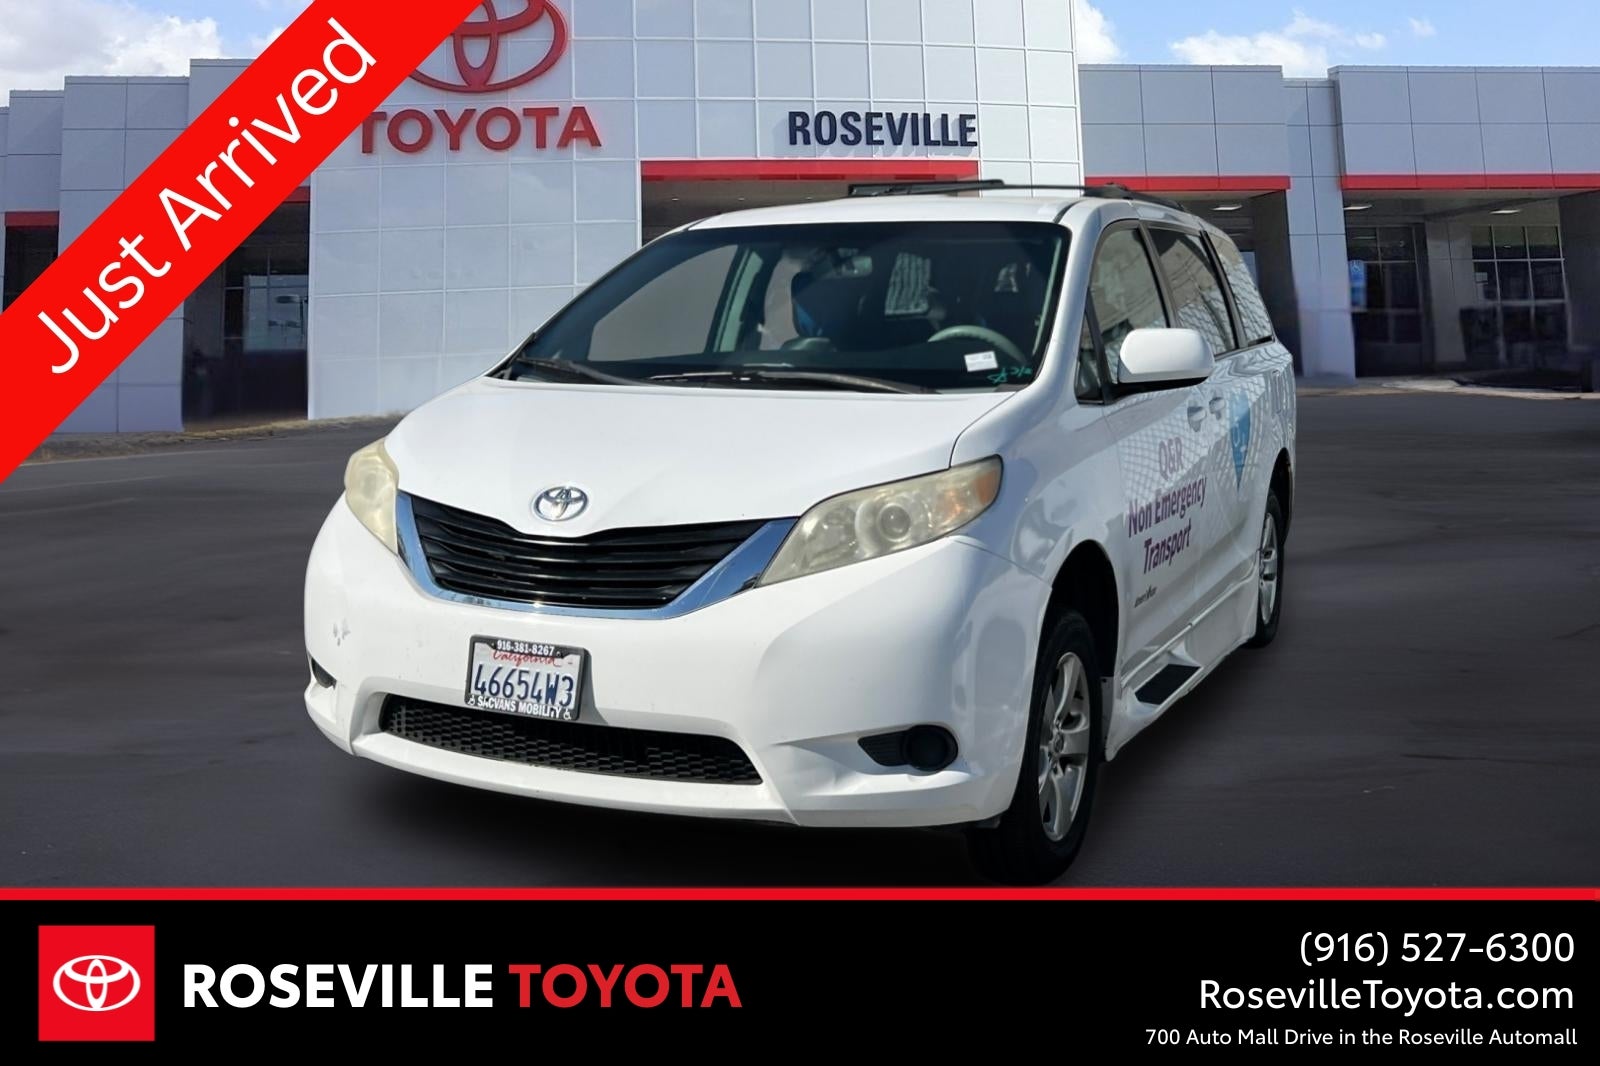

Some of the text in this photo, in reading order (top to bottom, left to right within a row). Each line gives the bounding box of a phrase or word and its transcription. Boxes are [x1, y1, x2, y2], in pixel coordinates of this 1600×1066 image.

[361, 106, 602, 154] TOYOTA
[788, 110, 978, 147] ROSEVILLE
[1158, 436, 1183, 481] Q&R
[1128, 476, 1207, 538] Non Emergency
[1143, 518, 1192, 575] Transport
[496, 639, 555, 656] 916-381-8267
[474, 663, 574, 708] 46654W3
